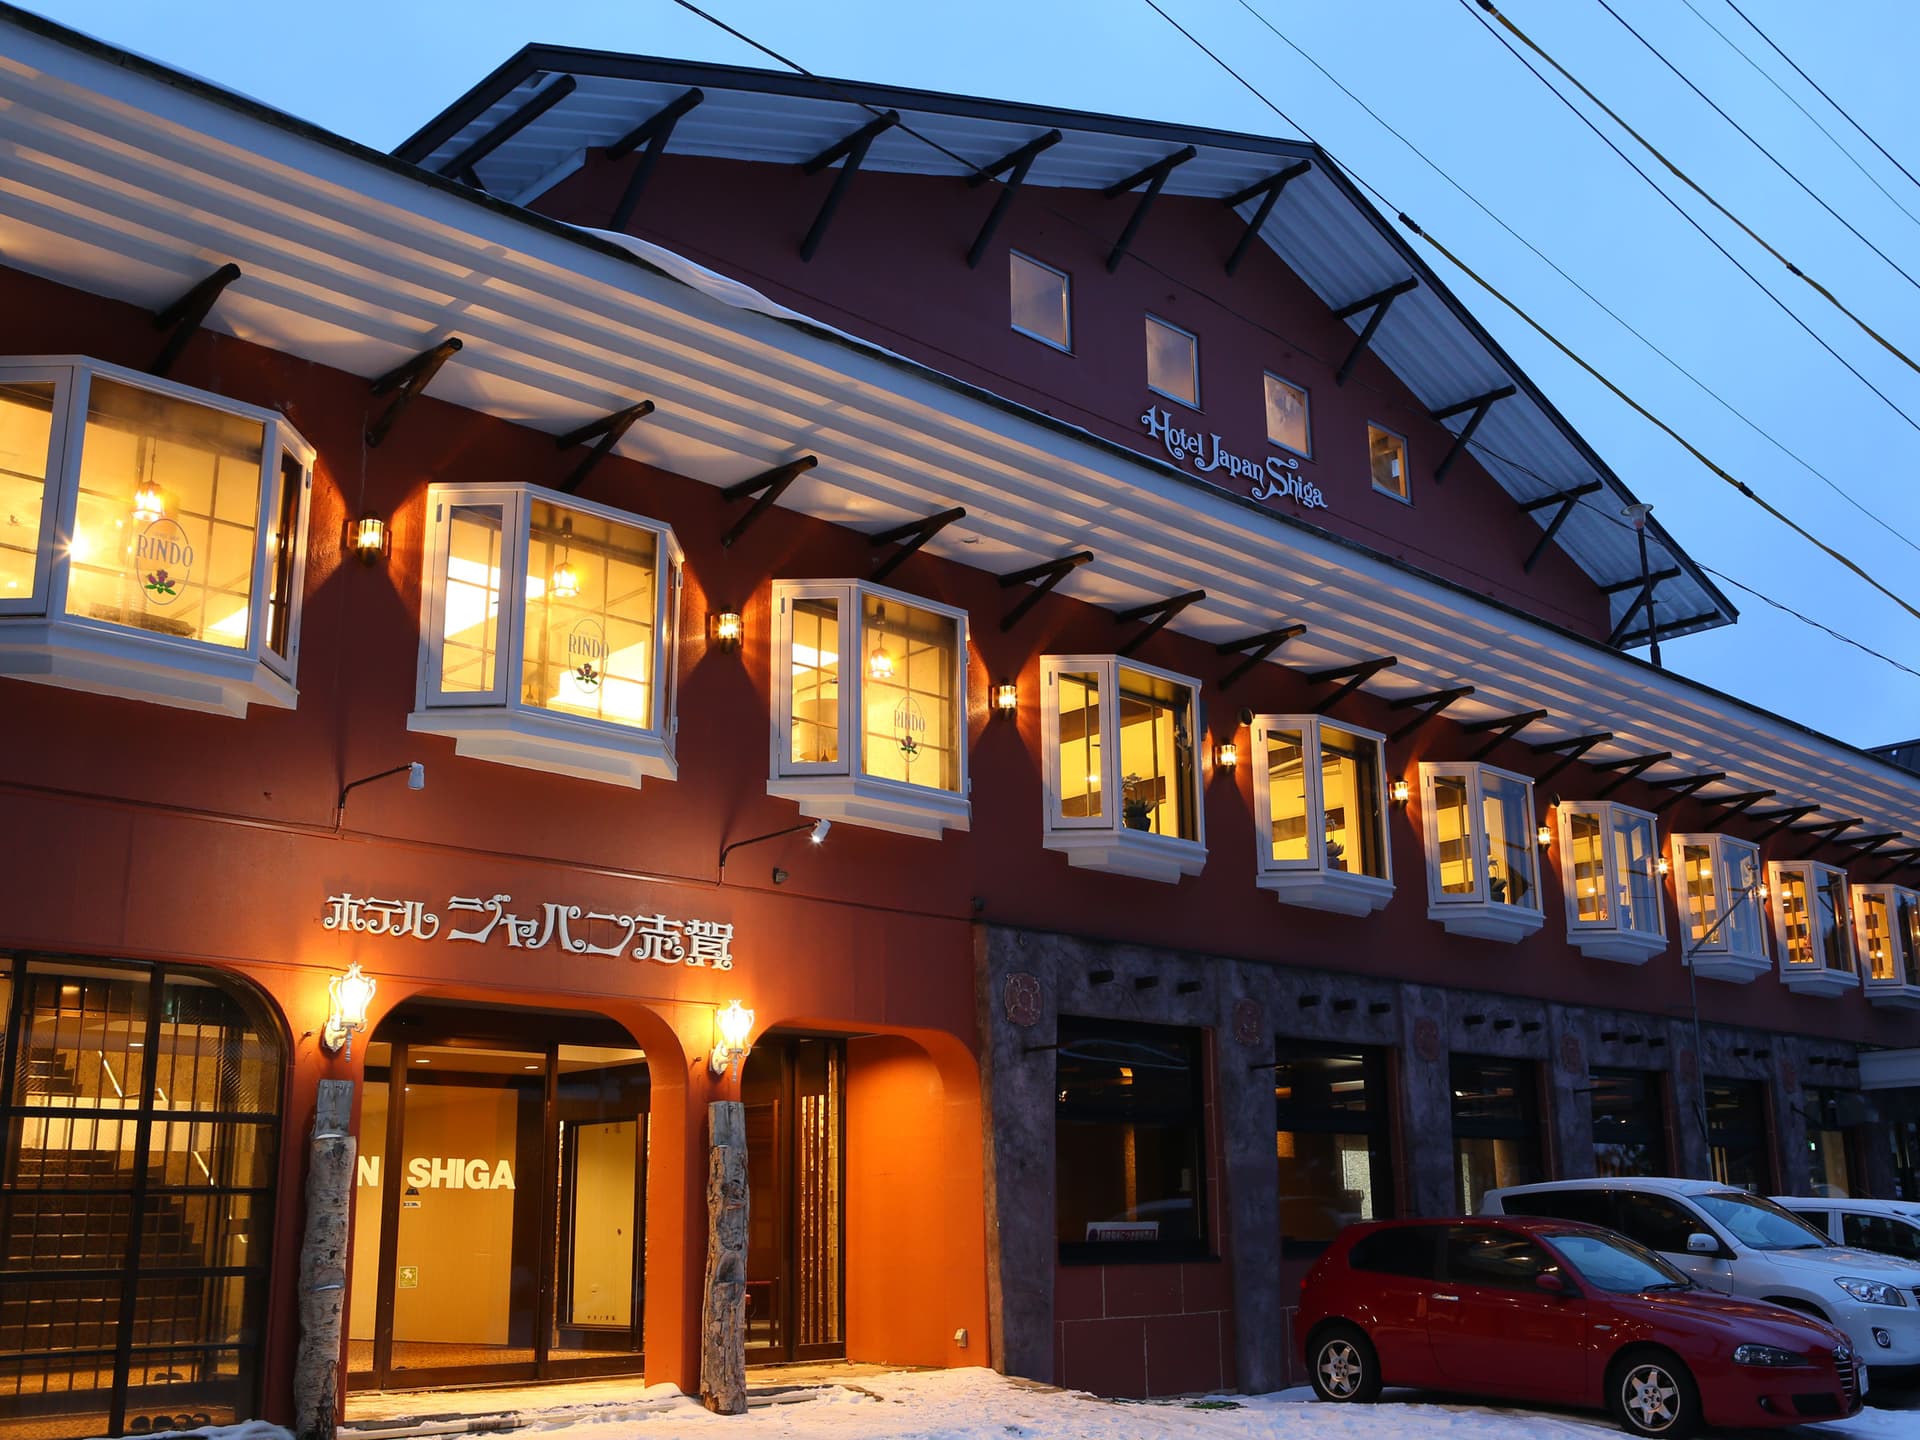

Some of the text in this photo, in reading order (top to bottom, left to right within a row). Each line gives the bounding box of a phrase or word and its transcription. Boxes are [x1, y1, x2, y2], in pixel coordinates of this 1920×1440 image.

[1141, 405, 1328, 508] Hotel Japan Shiga
[136, 534, 193, 567] RINDO
[569, 633, 609, 660] RINDO
[894, 710, 925, 732] RINDO
[322, 893, 733, 970] ホテル ジャパン志賀
[406, 1157, 516, 1190] SHIGA
